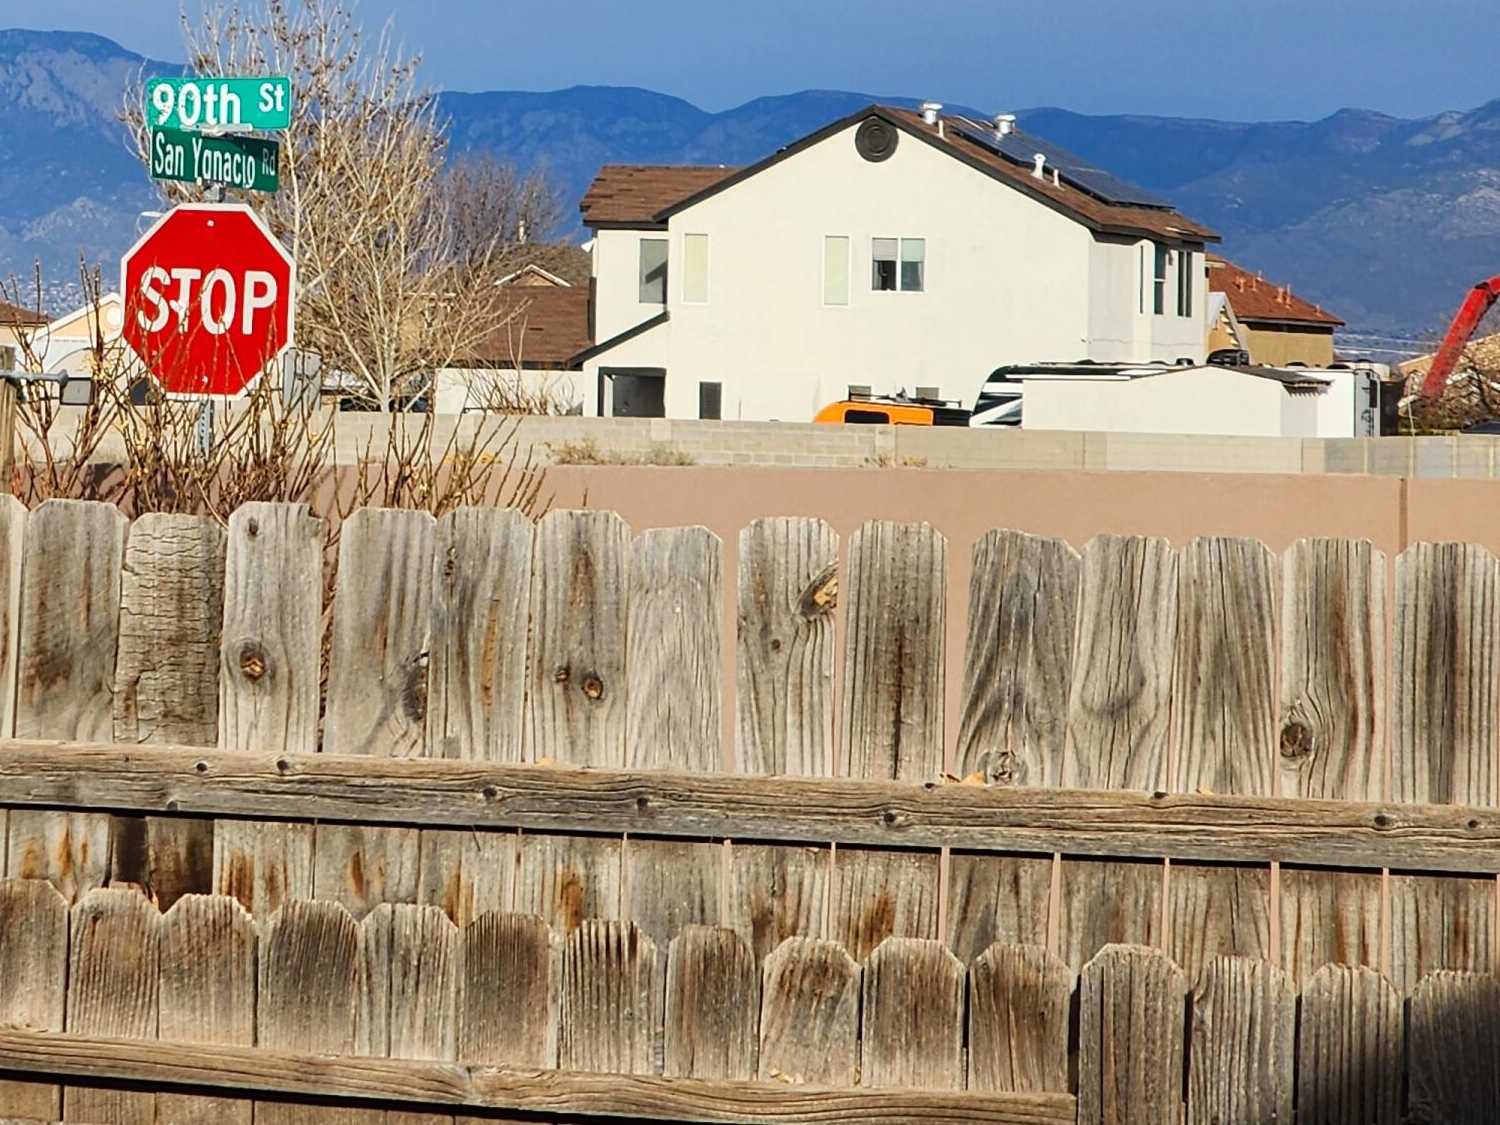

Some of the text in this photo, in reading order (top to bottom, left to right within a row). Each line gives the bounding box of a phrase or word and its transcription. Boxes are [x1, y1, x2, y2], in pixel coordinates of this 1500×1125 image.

[152, 82, 285, 125] 90th St
[155, 132, 185, 177] San
[262, 148, 276, 176] Rd
[137, 267, 278, 335] STOP
